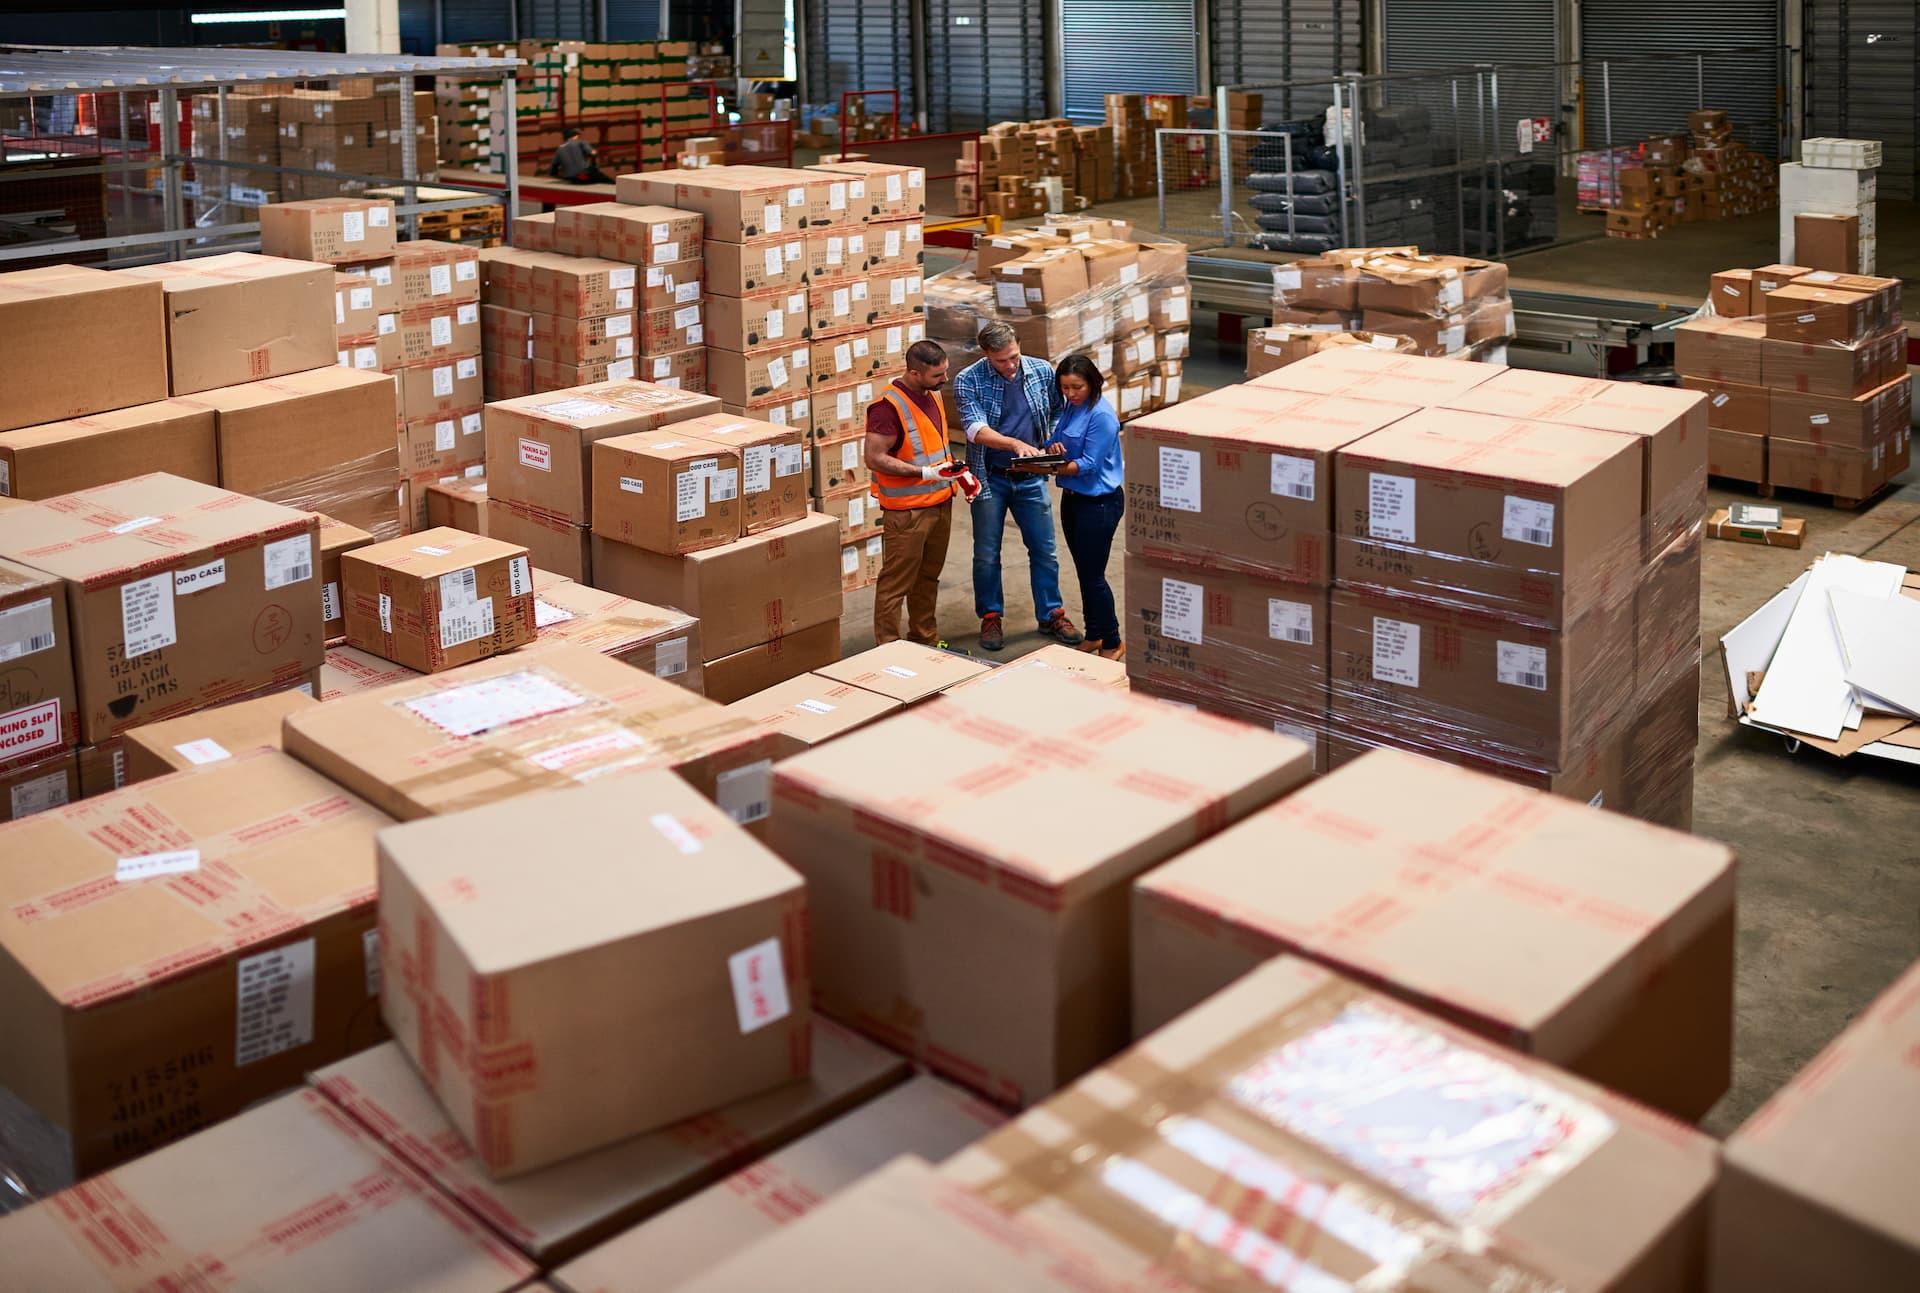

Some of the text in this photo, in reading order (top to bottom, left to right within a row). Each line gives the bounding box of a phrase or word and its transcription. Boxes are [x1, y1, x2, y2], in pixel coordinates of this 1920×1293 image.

[521, 444, 548, 457] PACKING SLIP
[525, 454, 545, 464] ENCLOSED
[702, 461, 717, 469] CASE
[620, 478, 643, 488] ODD CASE
[264, 518, 308, 536] WARNING
[1133, 513, 1176, 529] BLACK
[213, 533, 259, 550] WARNING
[139, 552, 187, 570] WARNING
[512, 559, 520, 578] CASE
[83, 566, 133, 585] WARNING
[176, 565, 224, 586] ODD CASE
[323, 583, 331, 604] CASE
[430, 632, 438, 667] WARNING
[117, 663, 170, 694] BLACK
[31, 711, 53, 726] SLIP
